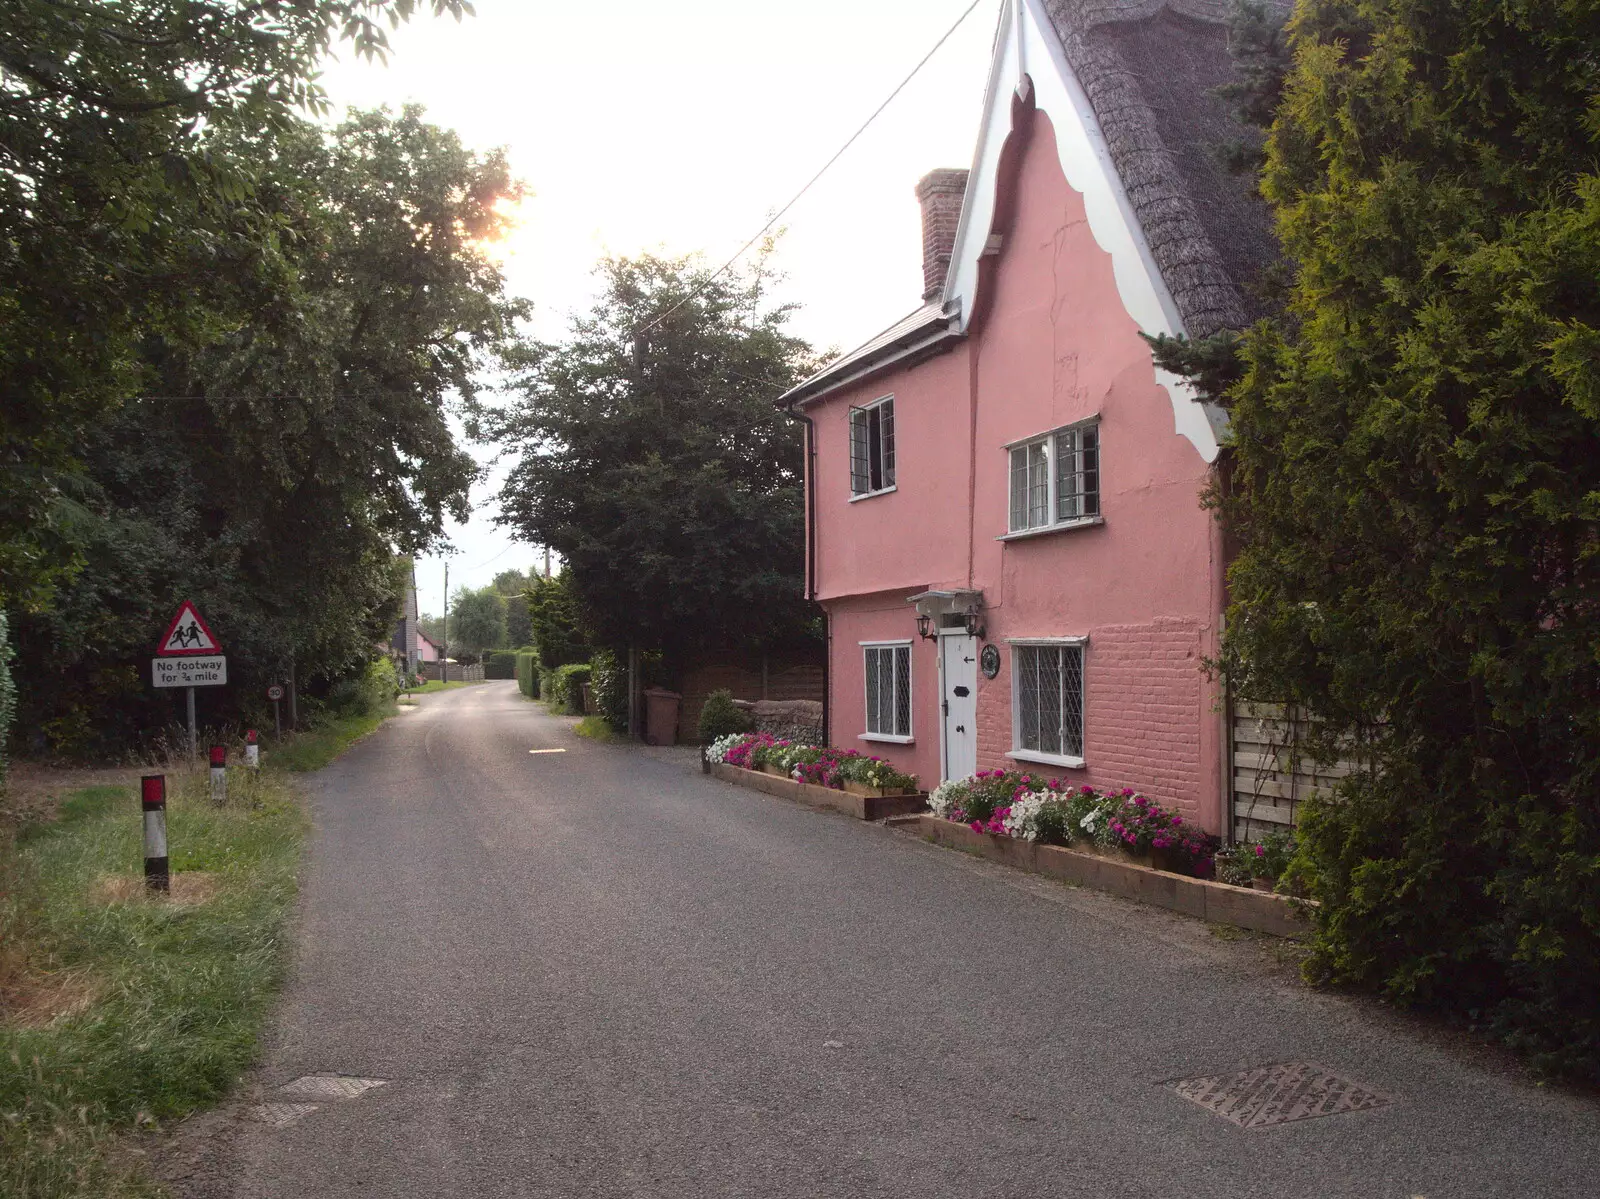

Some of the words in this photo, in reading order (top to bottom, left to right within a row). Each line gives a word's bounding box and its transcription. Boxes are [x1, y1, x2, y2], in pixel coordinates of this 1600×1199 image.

[157, 662, 173, 671] No
[177, 660, 222, 670] footway
[161, 673, 177, 682] for
[195, 671, 218, 681] mile
